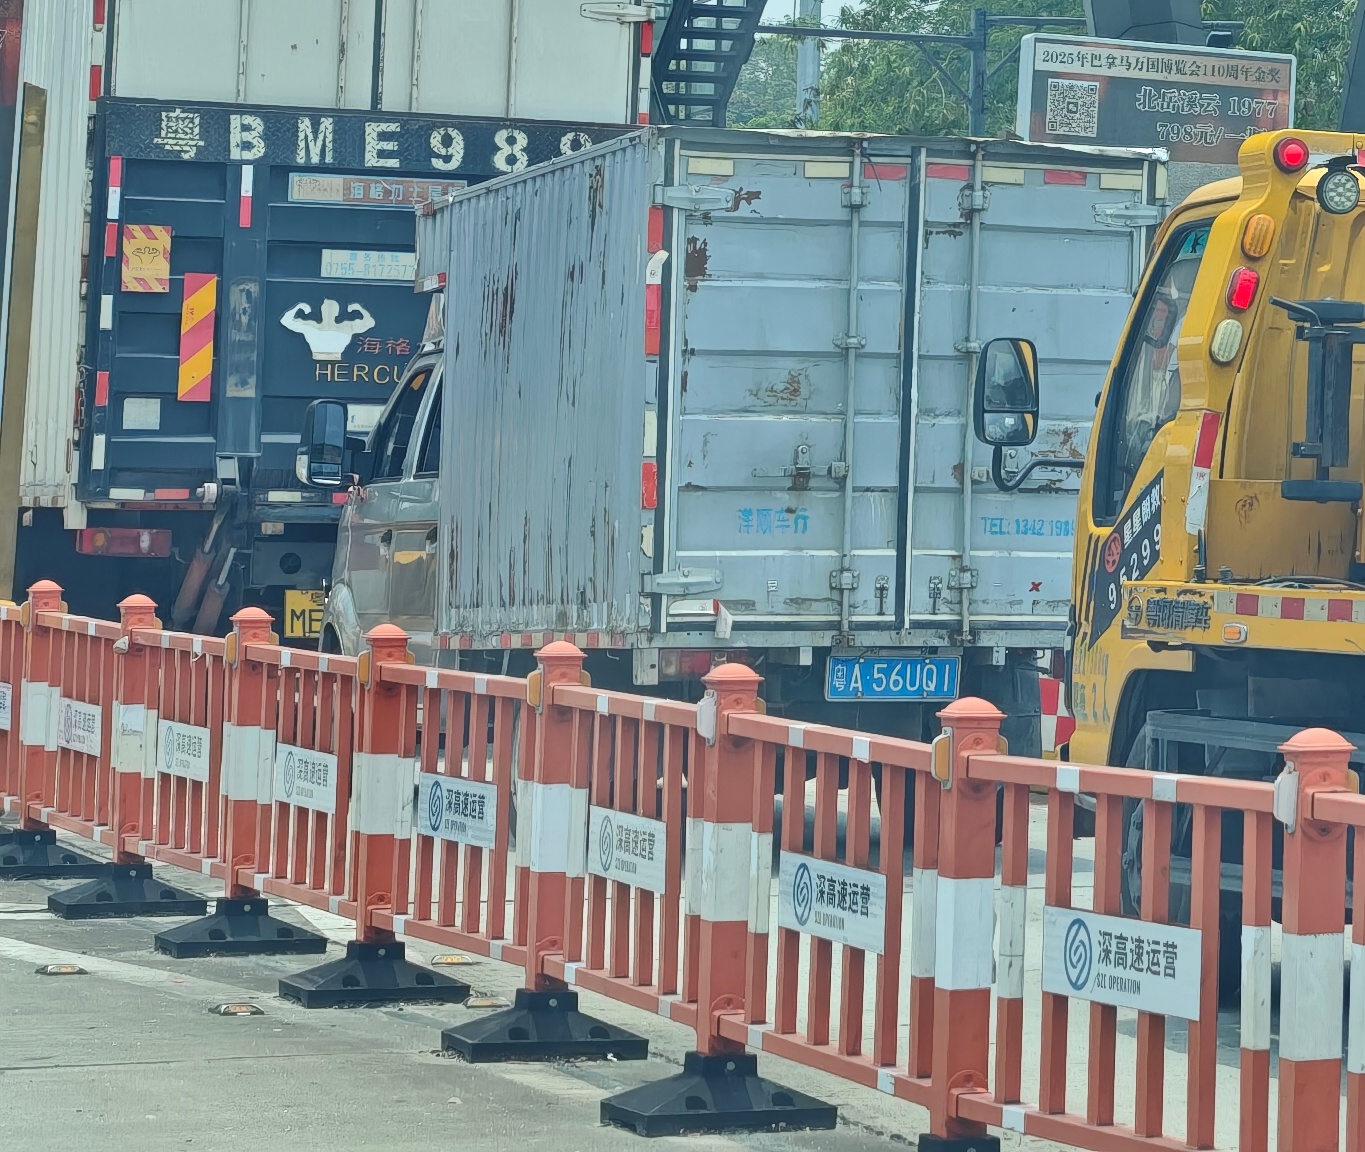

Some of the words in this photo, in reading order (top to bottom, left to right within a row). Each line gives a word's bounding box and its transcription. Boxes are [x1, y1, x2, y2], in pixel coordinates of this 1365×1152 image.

[1228, 97, 1278, 119] 1977
[815, 873, 871, 918] 深高速运营
[1097, 930, 1178, 979] 深高速运营
[1108, 974, 1141, 996] OPERATION
